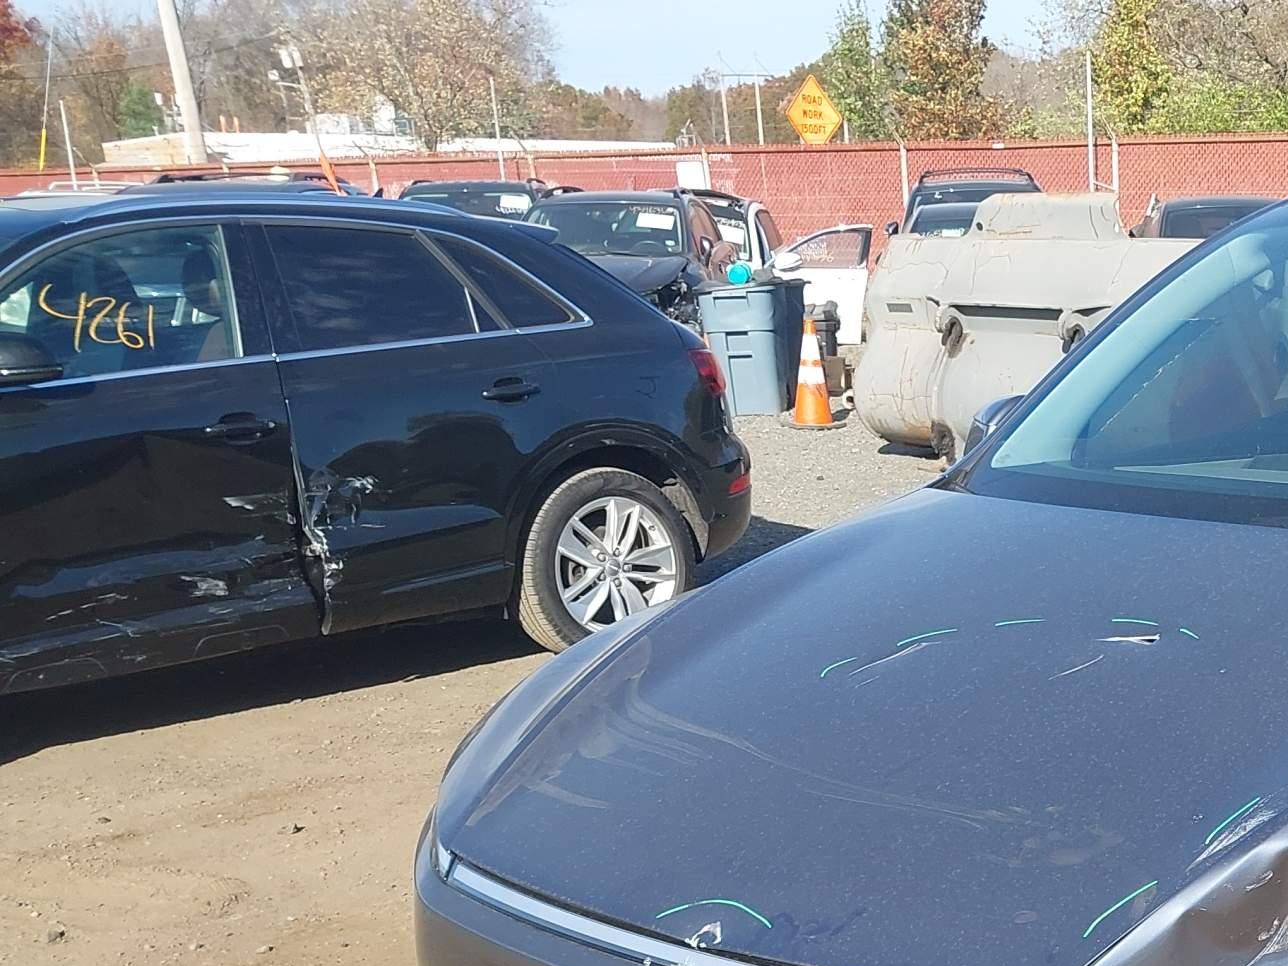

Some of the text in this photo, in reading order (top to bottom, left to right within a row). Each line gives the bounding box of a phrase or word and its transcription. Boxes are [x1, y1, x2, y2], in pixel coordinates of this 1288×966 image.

[801, 94, 823, 107] ROAD
[802, 109, 824, 121] WORK
[38, 283, 155, 353] 4261
